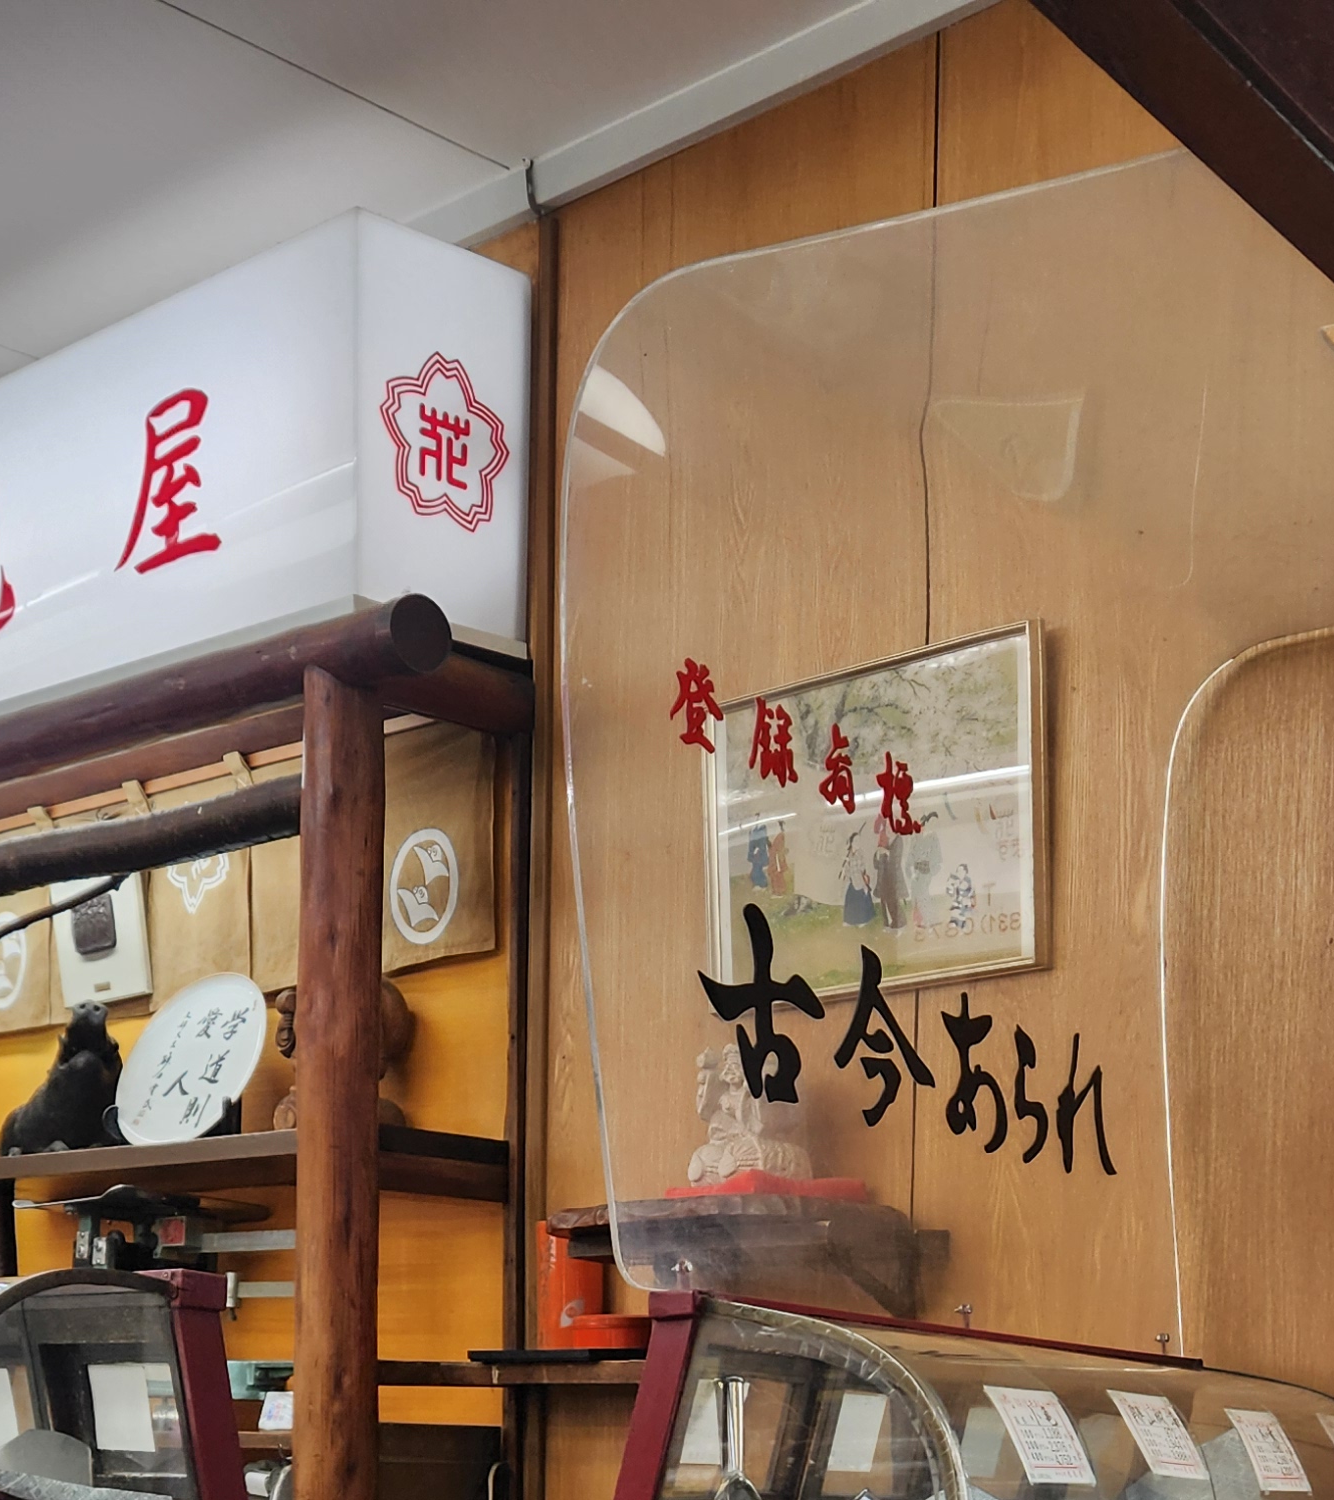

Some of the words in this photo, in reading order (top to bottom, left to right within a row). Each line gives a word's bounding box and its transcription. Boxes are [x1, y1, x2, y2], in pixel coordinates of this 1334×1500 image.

[697, 903, 1116, 1175] 古今あられ
